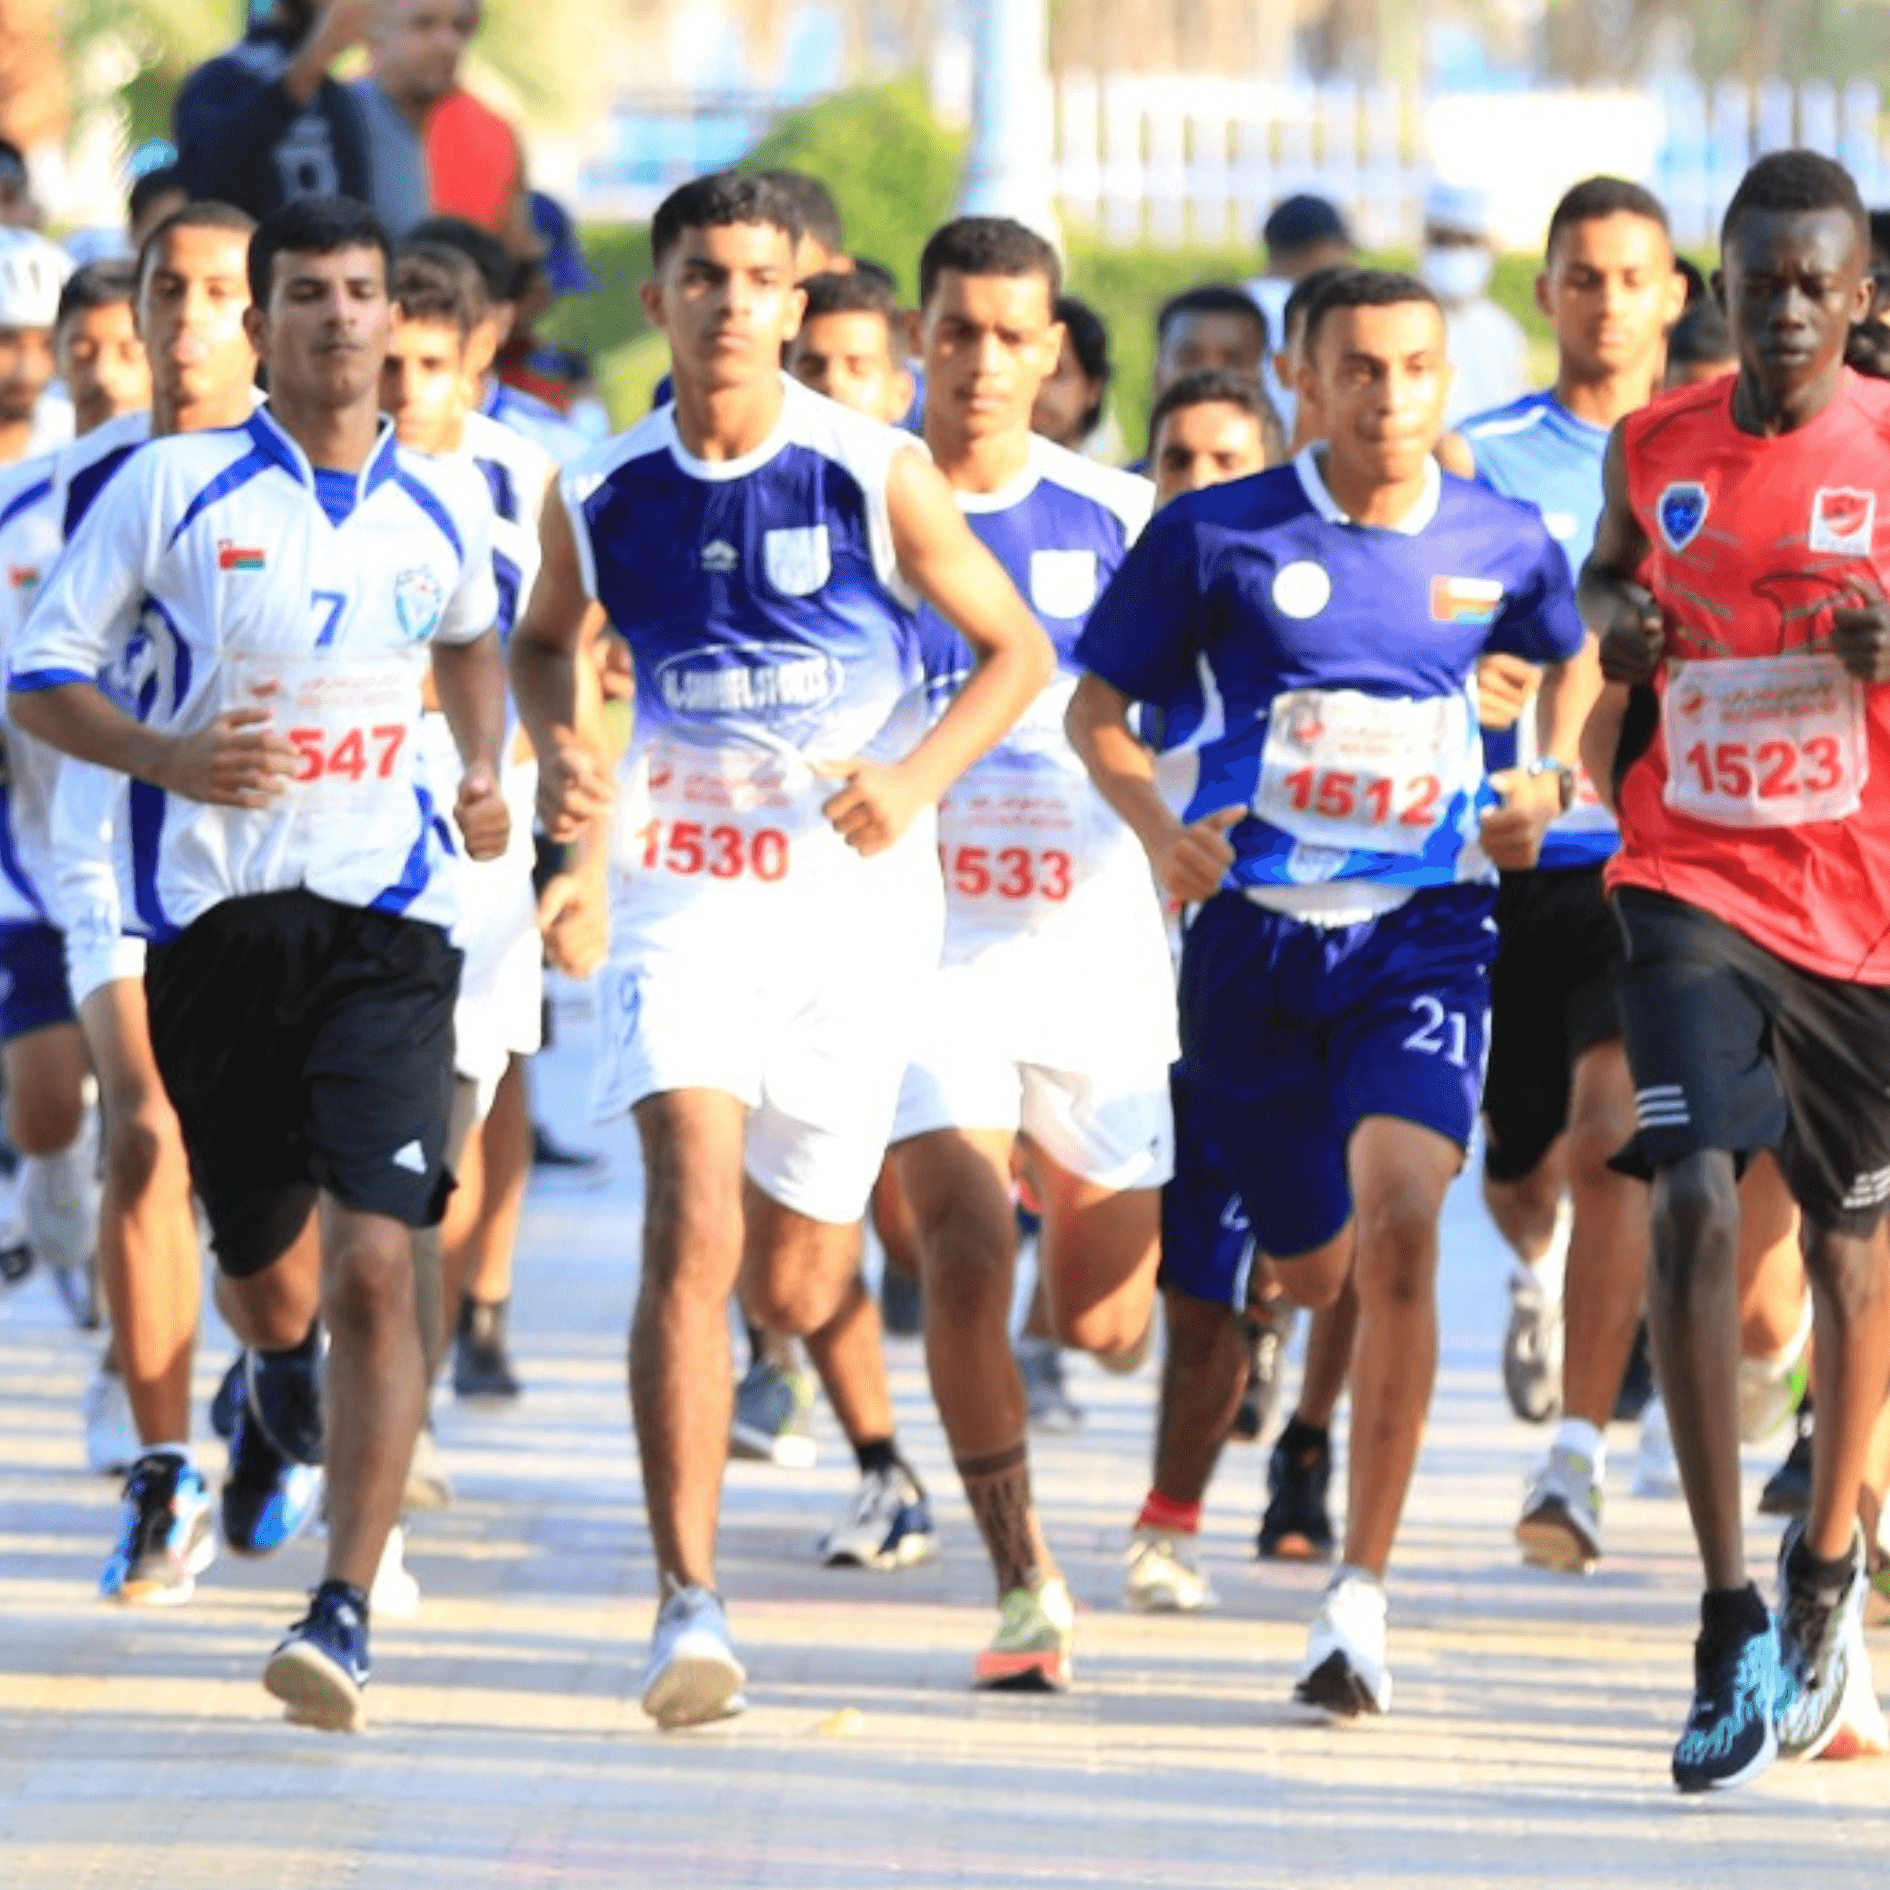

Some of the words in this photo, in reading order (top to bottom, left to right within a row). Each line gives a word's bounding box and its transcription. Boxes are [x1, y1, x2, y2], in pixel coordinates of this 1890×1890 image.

[311, 588, 347, 647] 7
[286, 725, 406, 784] 547
[1685, 734, 1843, 799] 1523
[1284, 765, 1441, 827] 1512
[636, 818, 789, 882] 1530
[938, 842, 1074, 902] 533
[1401, 994, 1468, 1068] 21
